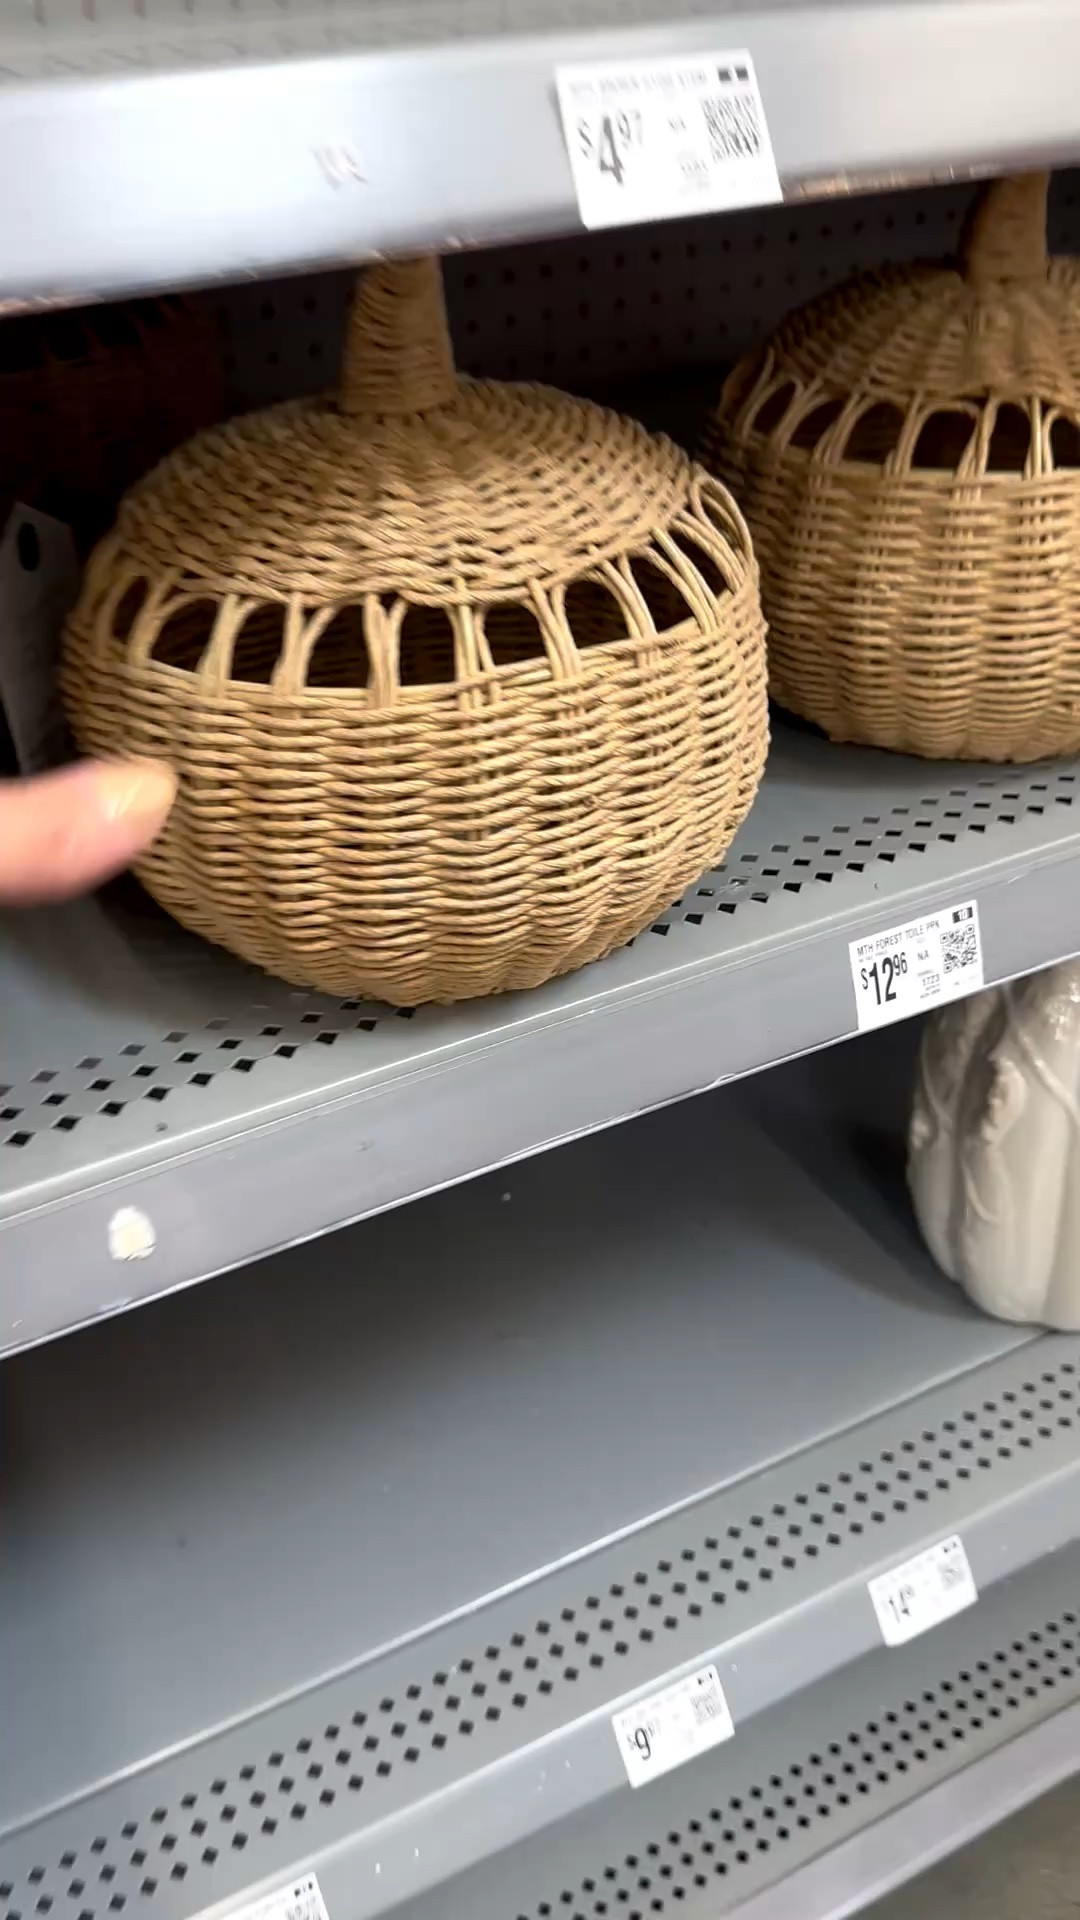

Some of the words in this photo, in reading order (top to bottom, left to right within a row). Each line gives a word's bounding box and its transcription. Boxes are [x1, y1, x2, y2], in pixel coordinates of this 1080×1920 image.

[857, 945, 874, 956] MTH
[876, 932, 902, 949] FOREST
[917, 950, 929, 961] NA
